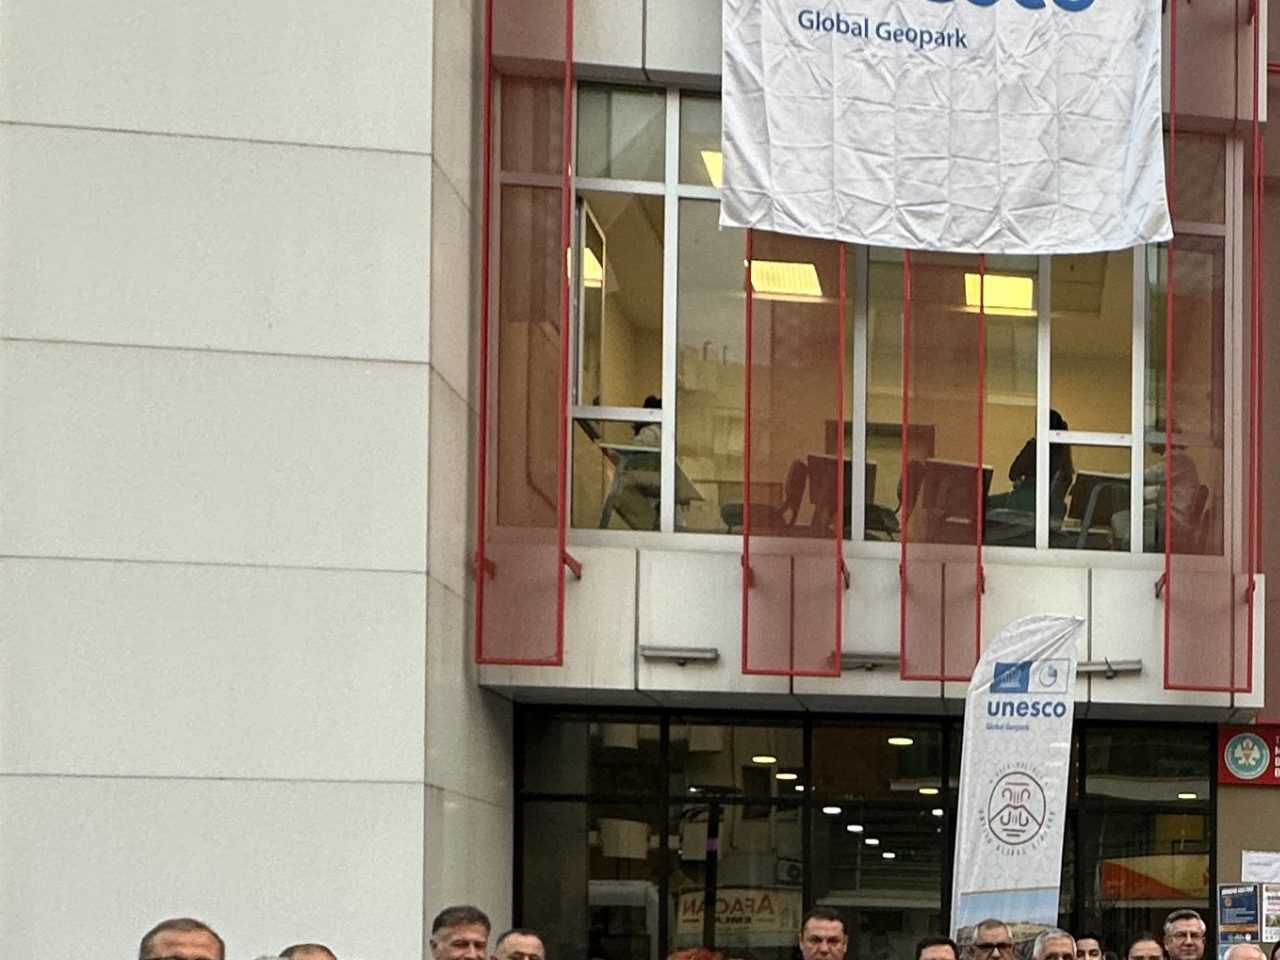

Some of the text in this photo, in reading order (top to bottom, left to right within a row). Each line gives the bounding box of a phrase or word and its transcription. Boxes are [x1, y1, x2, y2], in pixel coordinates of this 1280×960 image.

[798, 10, 968, 49] Global Geopark
[987, 700, 1067, 718] unesco
